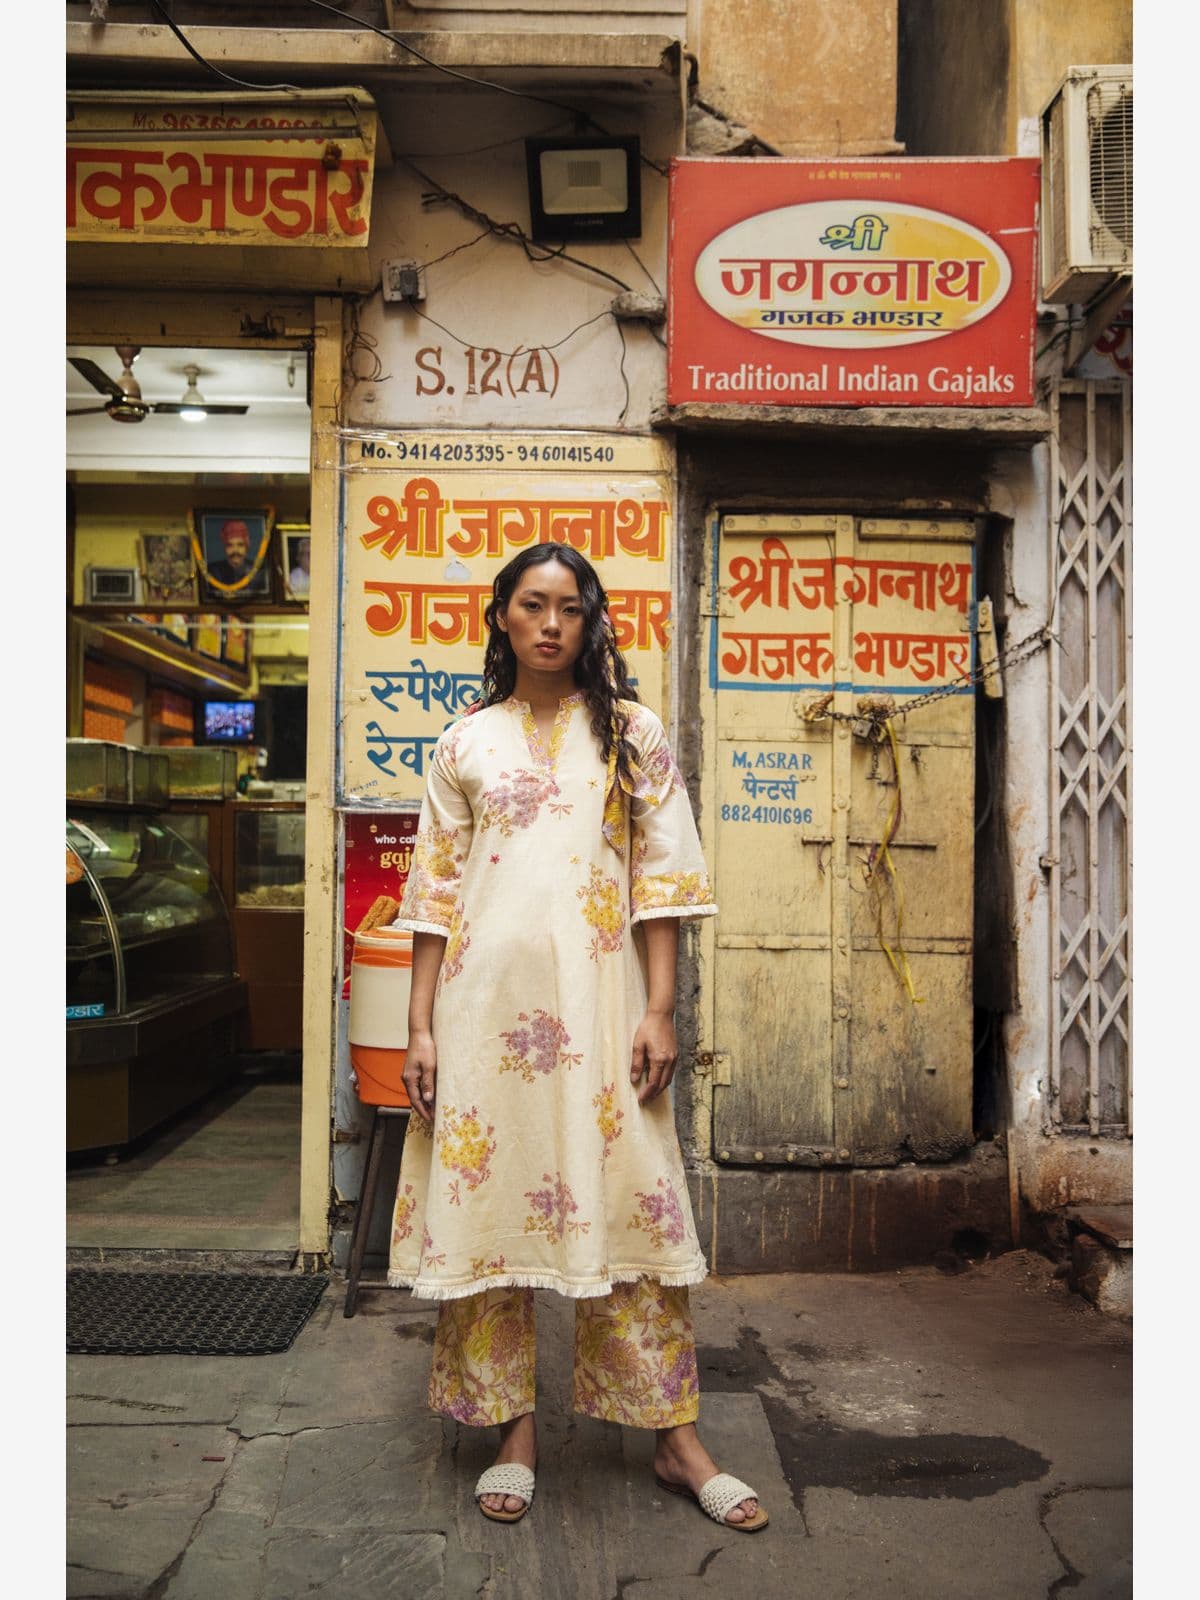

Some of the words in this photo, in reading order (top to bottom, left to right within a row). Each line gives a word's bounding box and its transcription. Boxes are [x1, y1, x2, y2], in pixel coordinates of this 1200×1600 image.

[819, 214, 888, 251] श्री
[719, 259, 986, 303] जगन्नाथ
[760, 310, 845, 326] गजक
[851, 311, 945, 328] भण्डार
[688, 365, 828, 392] Traditional
[838, 366, 919, 393] Indian
[928, 367, 1015, 399] Gajaks
[361, 442, 392, 460] Mo.
[364, 581, 493, 645] गज
[721, 632, 834, 681] गजक
[853, 632, 972, 683] भण्डार
[721, 804, 814, 824] 8824101696
[374, 834, 397, 845] who
[380, 846, 413, 874] gaj
